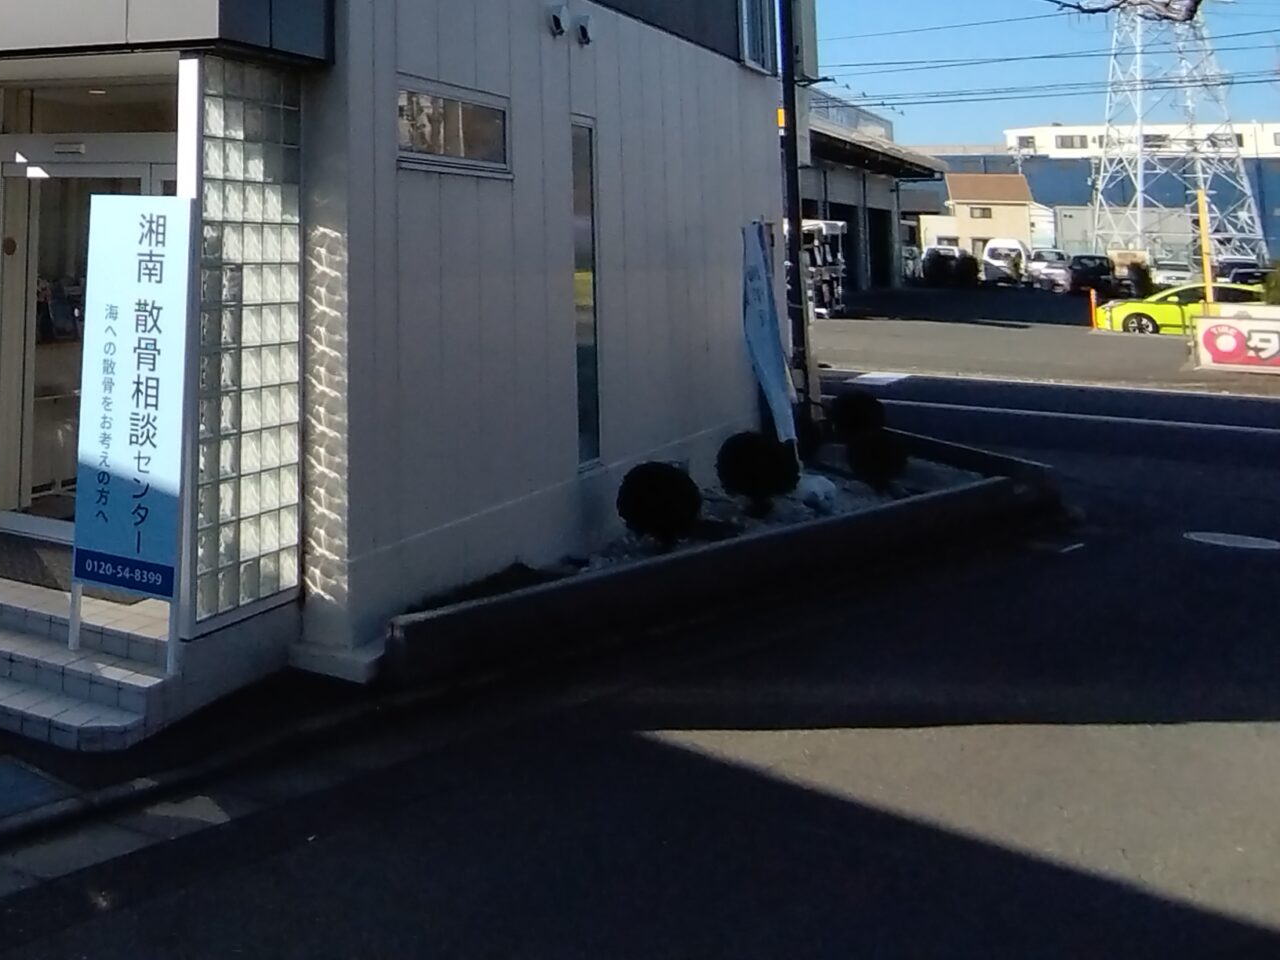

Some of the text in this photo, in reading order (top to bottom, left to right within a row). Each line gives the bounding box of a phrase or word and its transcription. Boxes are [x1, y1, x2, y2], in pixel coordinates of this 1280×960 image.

[95, 303, 119, 523] 海への散骨をお考えの方へ
[129, 213, 167, 554] 湘南 散骨相談センター
[85, 558, 163, 586] 0120-54-8399
